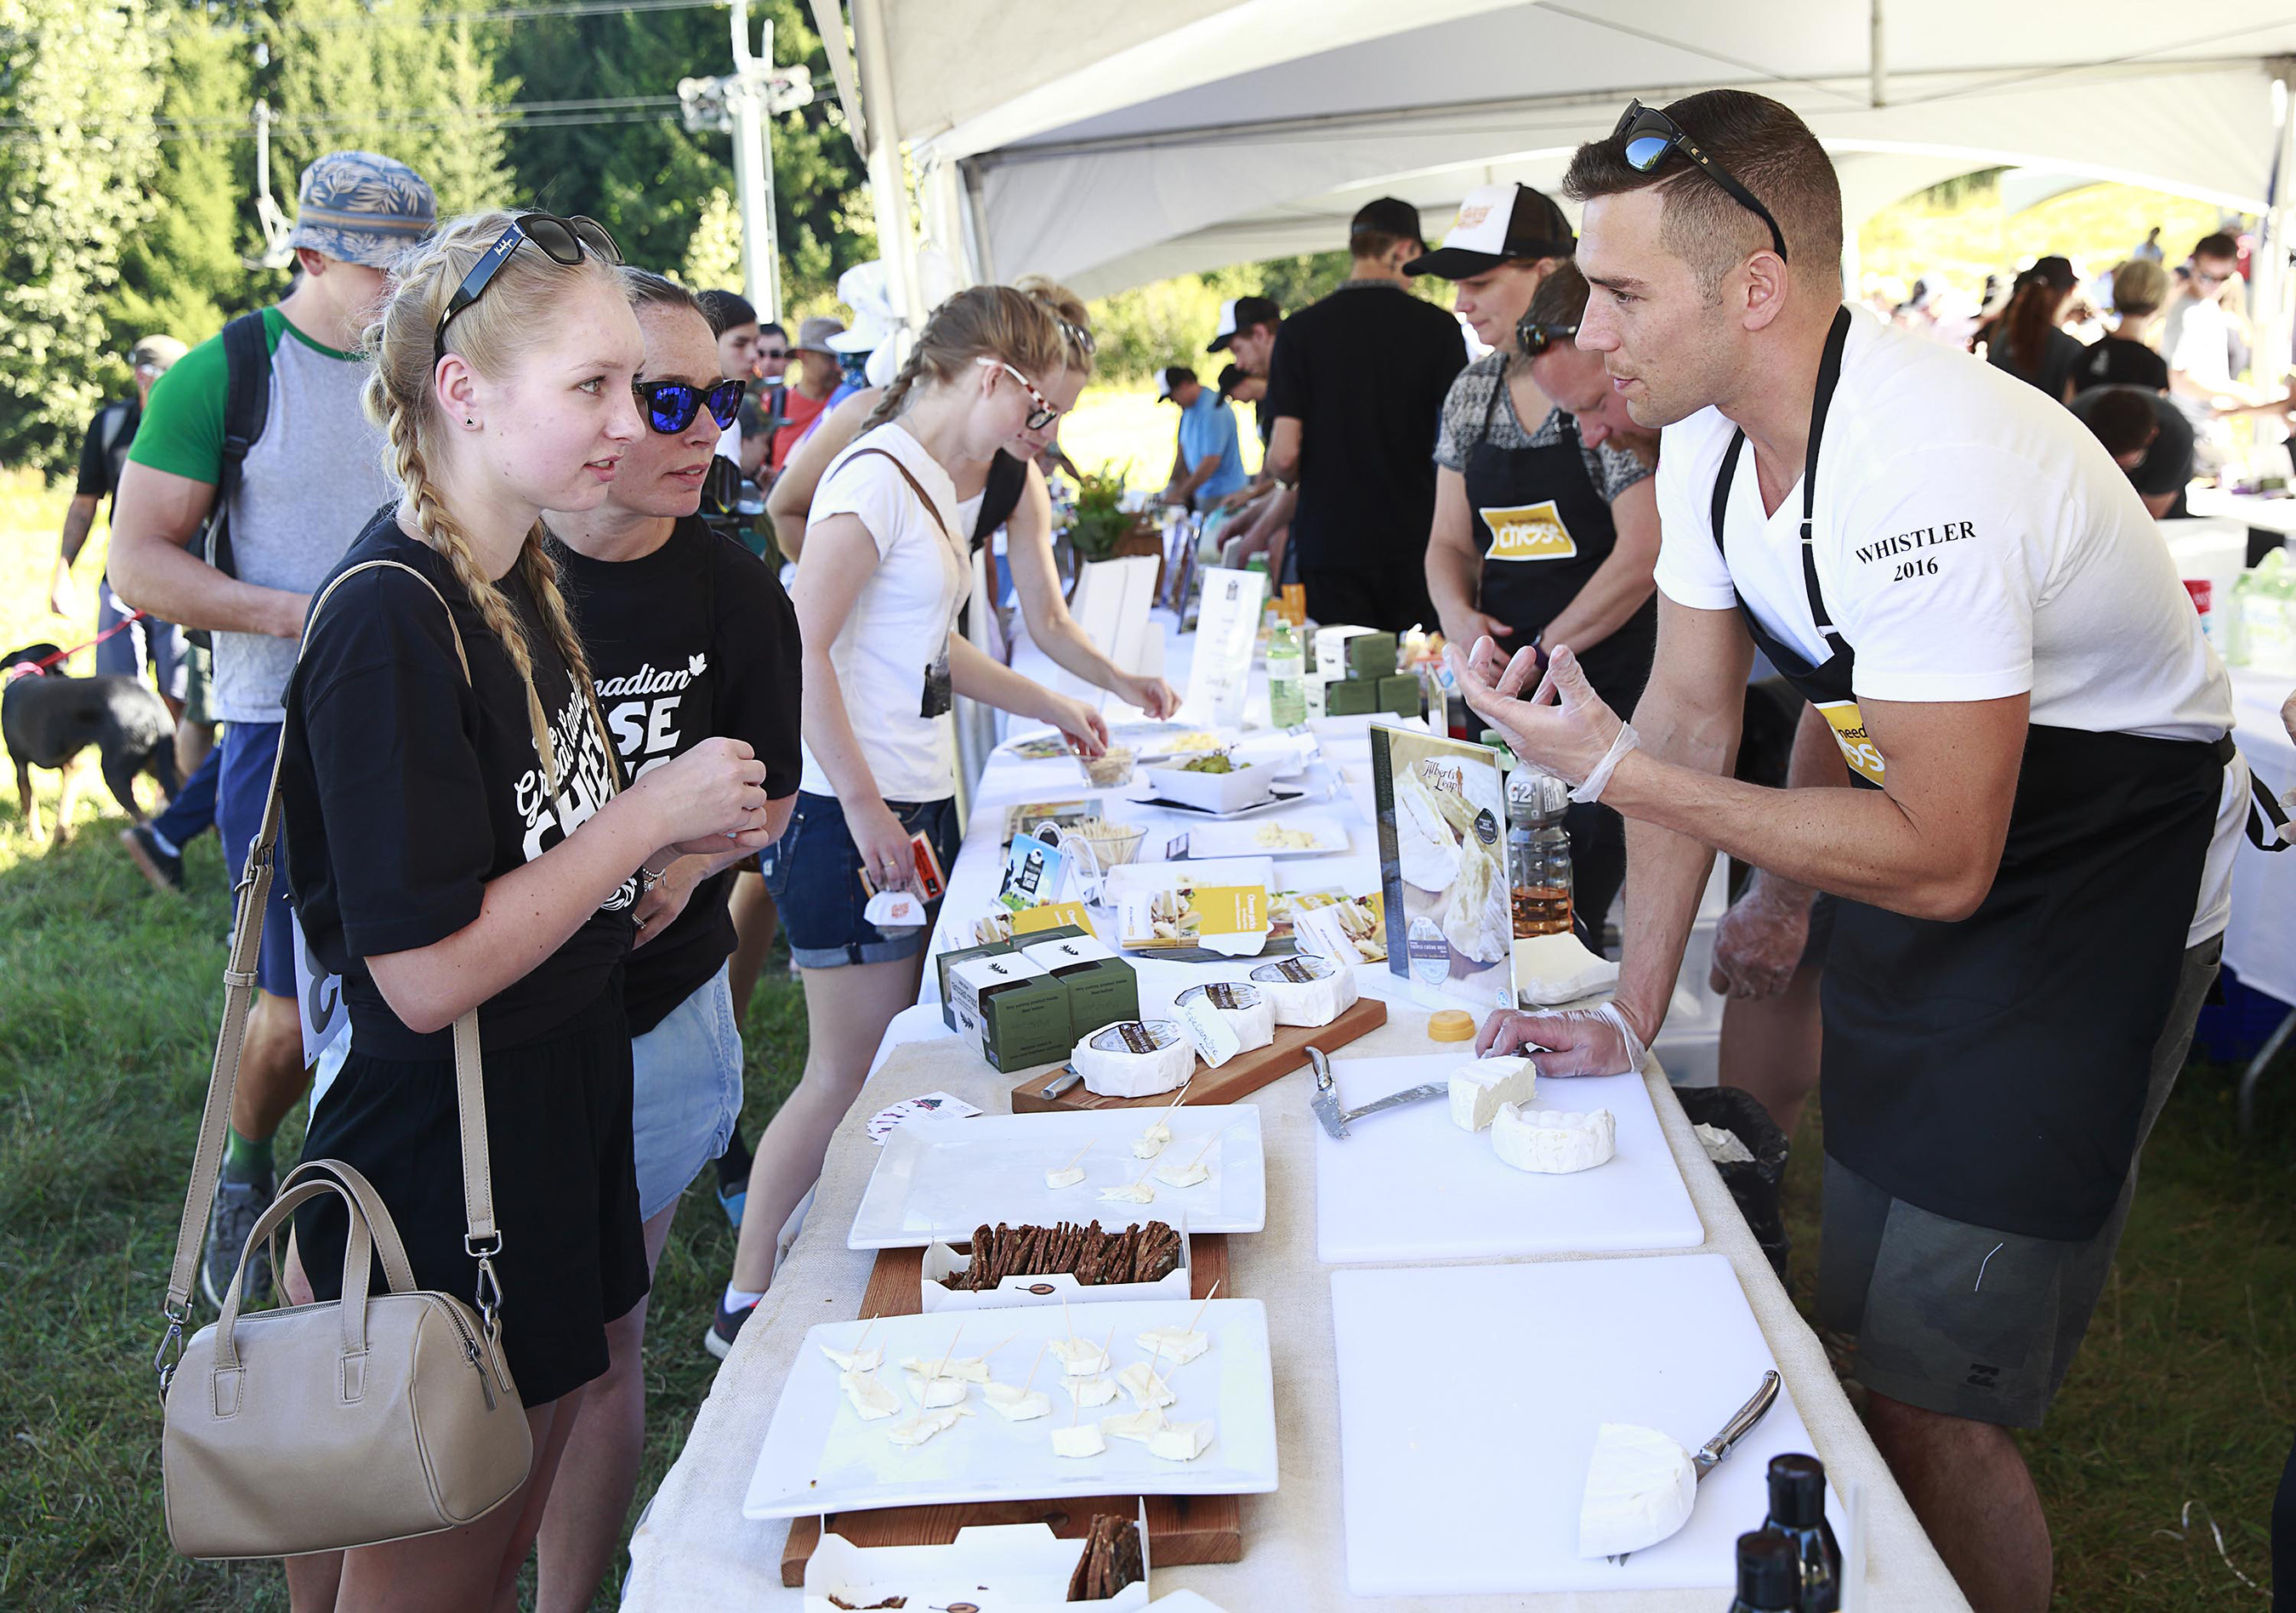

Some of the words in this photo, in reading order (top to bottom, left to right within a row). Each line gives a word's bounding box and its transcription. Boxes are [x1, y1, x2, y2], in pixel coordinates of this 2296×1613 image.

[1856, 521, 1976, 565] WHISTLER
[1894, 556, 1939, 582] 2016
[1838, 723, 1869, 739] need
[1434, 775, 1458, 792] Leap
